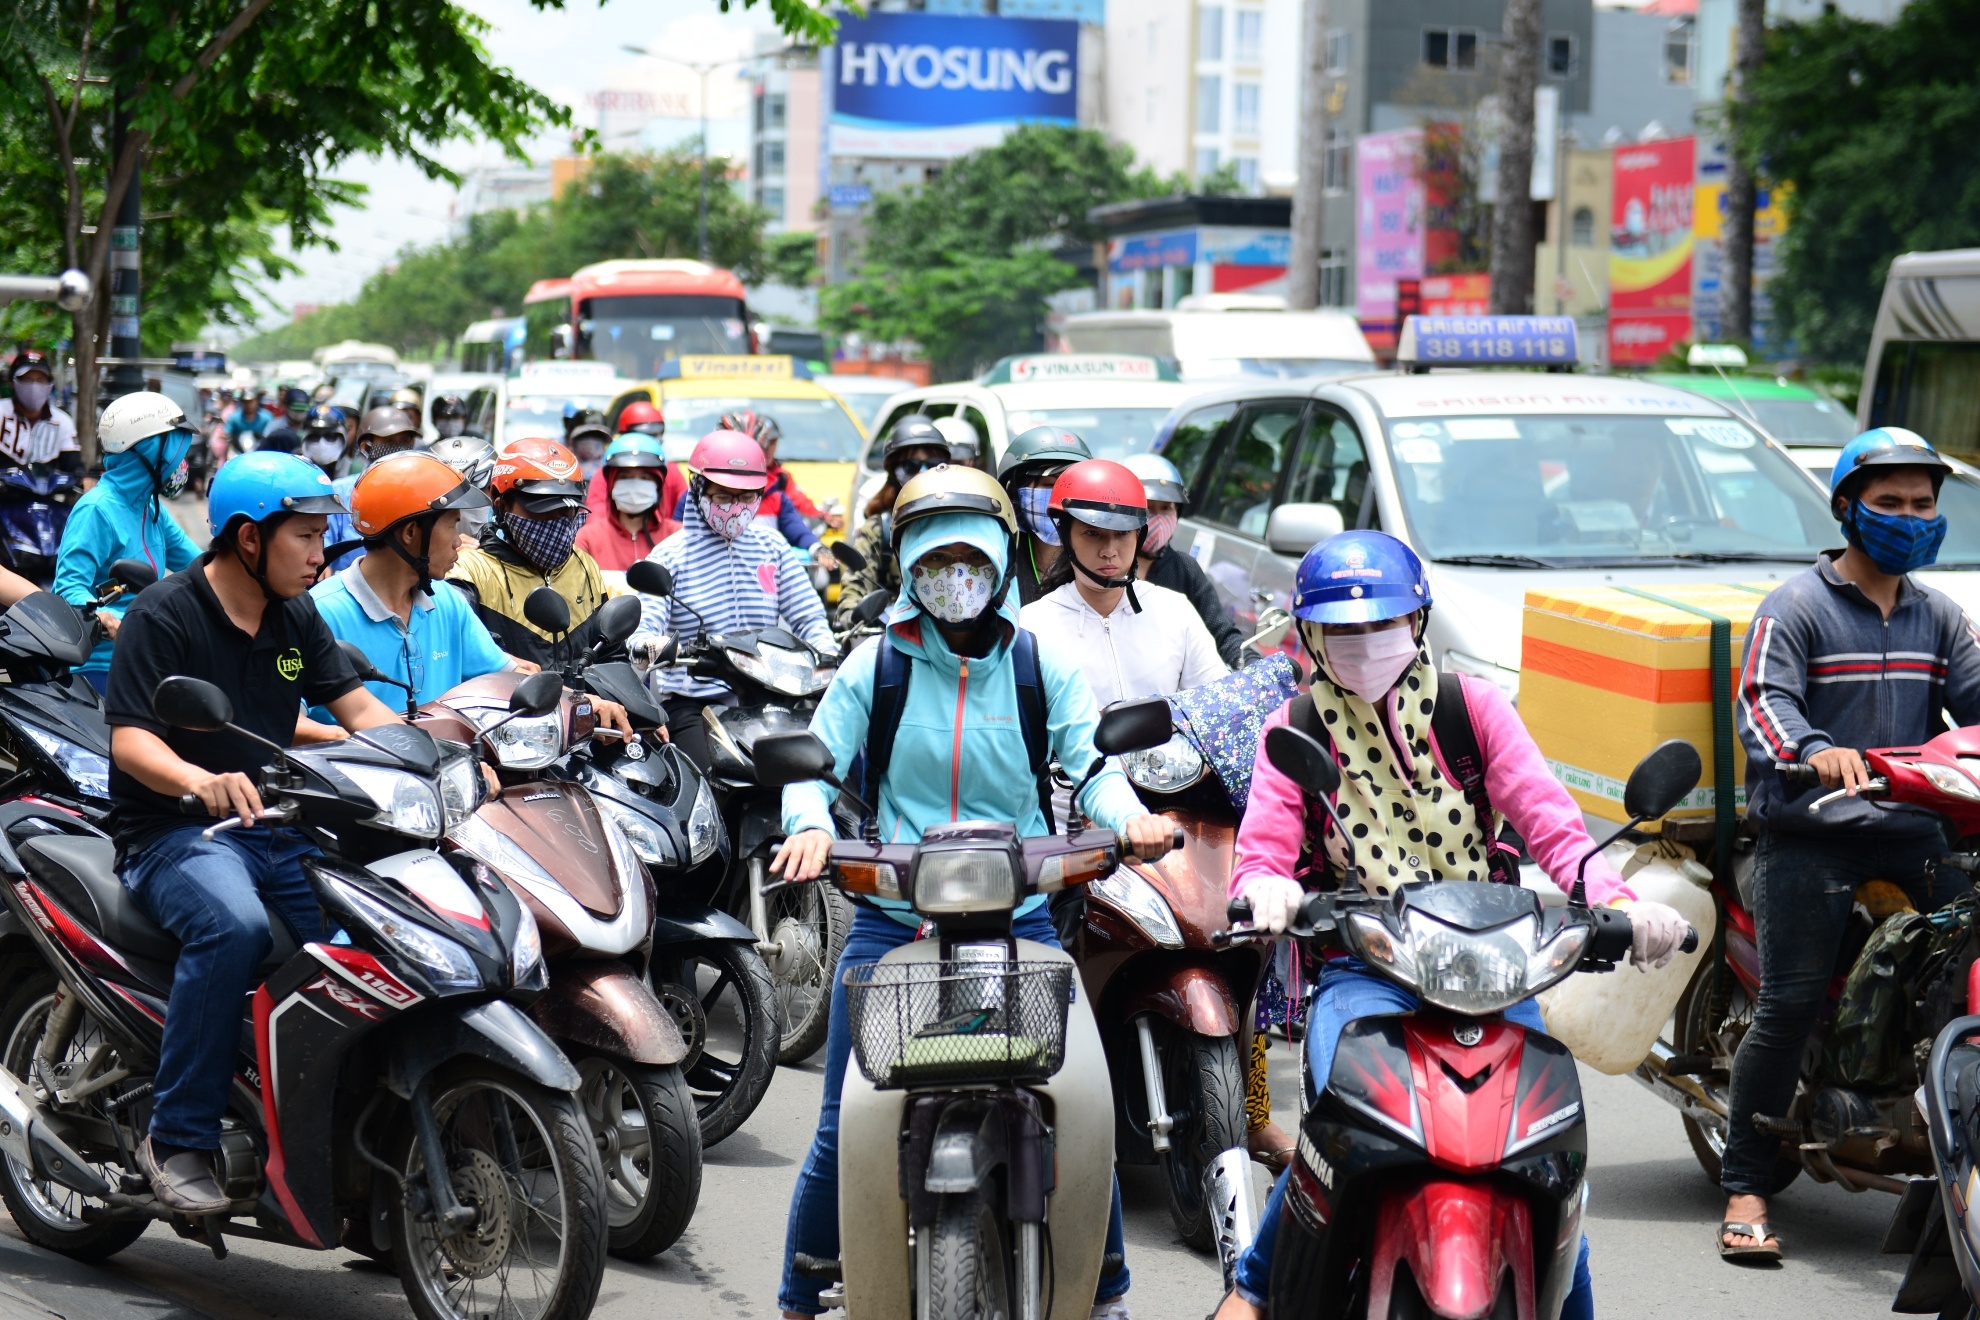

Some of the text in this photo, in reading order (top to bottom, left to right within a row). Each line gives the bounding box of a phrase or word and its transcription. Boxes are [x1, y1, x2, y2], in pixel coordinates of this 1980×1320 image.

[841, 41, 1072, 94] HYOSUNG
[1529, 319, 1569, 335] TAXI
[1426, 338, 1568, 358] 38 118 118
[693, 361, 785, 373] Vinataxi
[1043, 360, 1150, 375] VINASUN TAXI
[281, 657, 305, 672] HSA
[762, 705, 792, 714] HONDA
[709, 780, 730, 793] HONDA
[523, 792, 561, 803] HONDA
[1087, 922, 1112, 941] HONDA
[960, 951, 1001, 959] HONDA
[360, 971, 411, 1001] 110
[1299, 1128, 1335, 1191] YAMAHA
